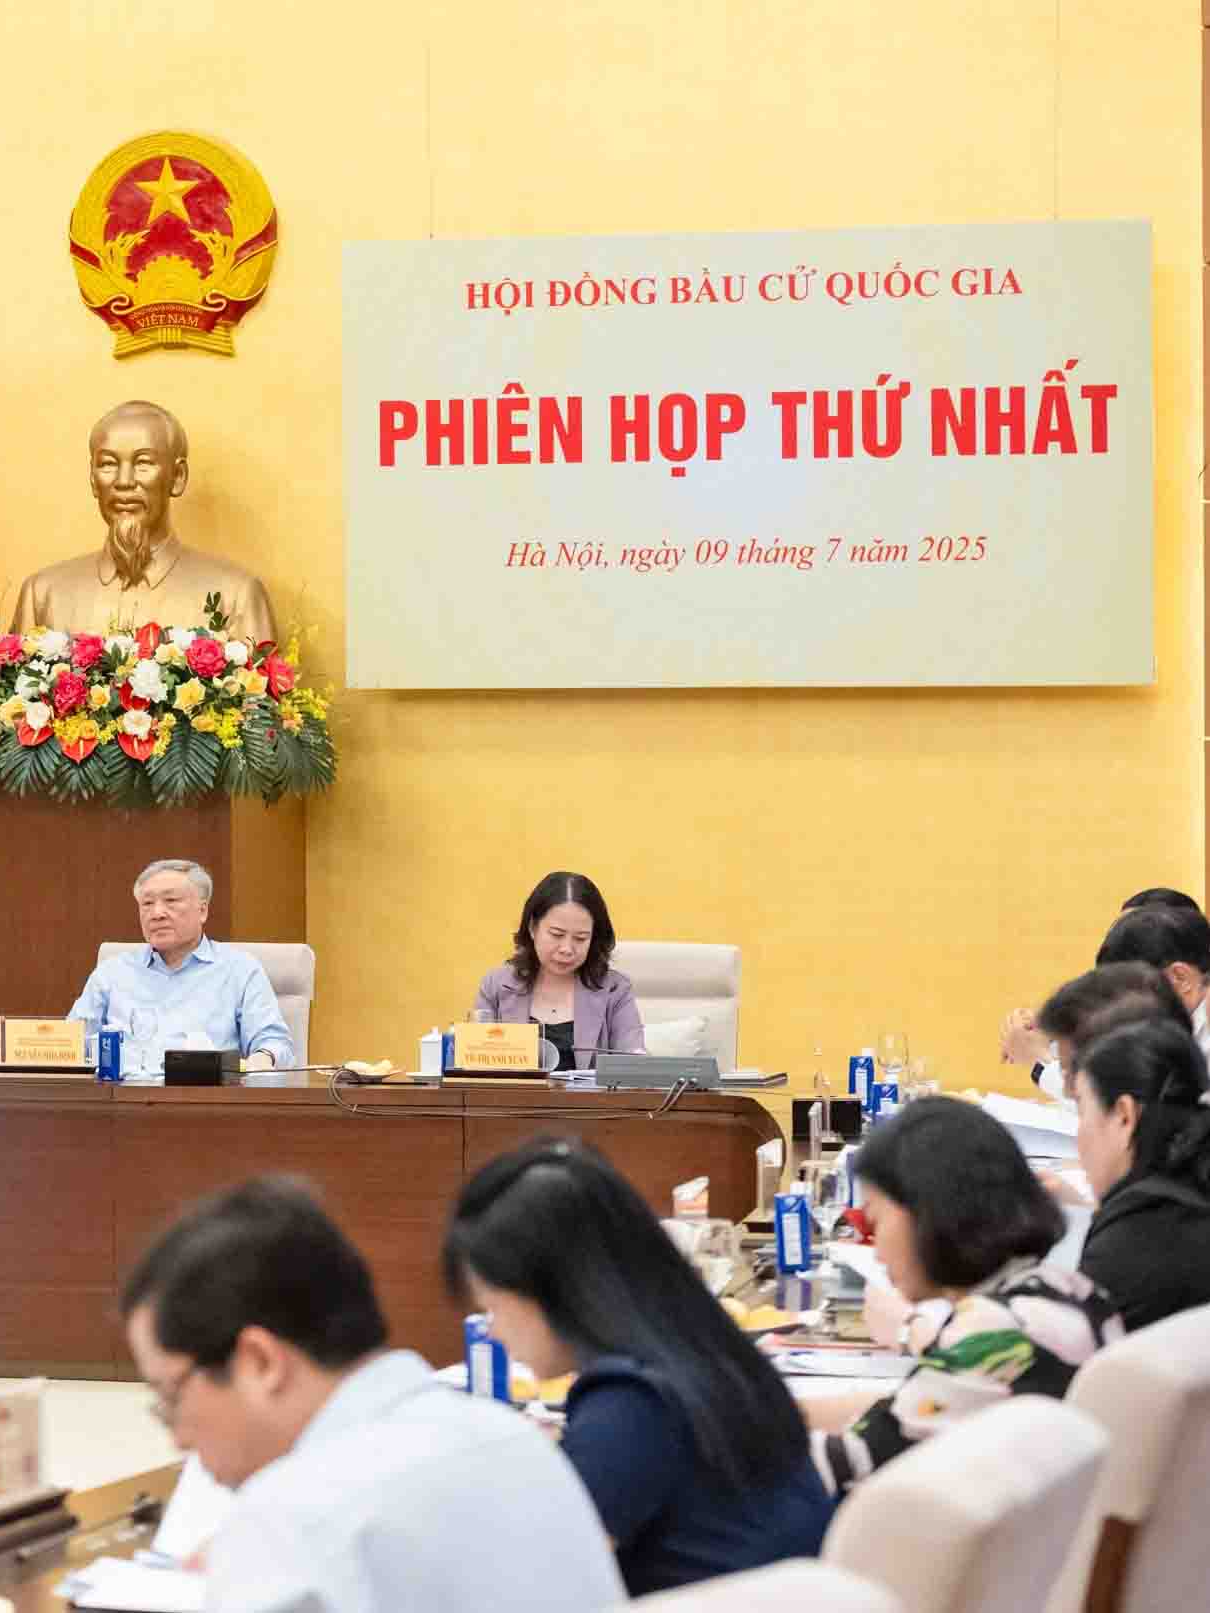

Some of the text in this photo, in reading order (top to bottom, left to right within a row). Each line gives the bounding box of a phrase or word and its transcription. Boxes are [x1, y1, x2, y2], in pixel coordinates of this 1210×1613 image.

[466, 262, 1023, 316] HỘI ĐỒNG BẦU CỬ QUỐC GIA
[378, 358, 1119, 479] PHIÊN HỌP THỨ NHẤT
[505, 535, 988, 573] Hà Nội, ngày 09 tháng 7 năm 2025
